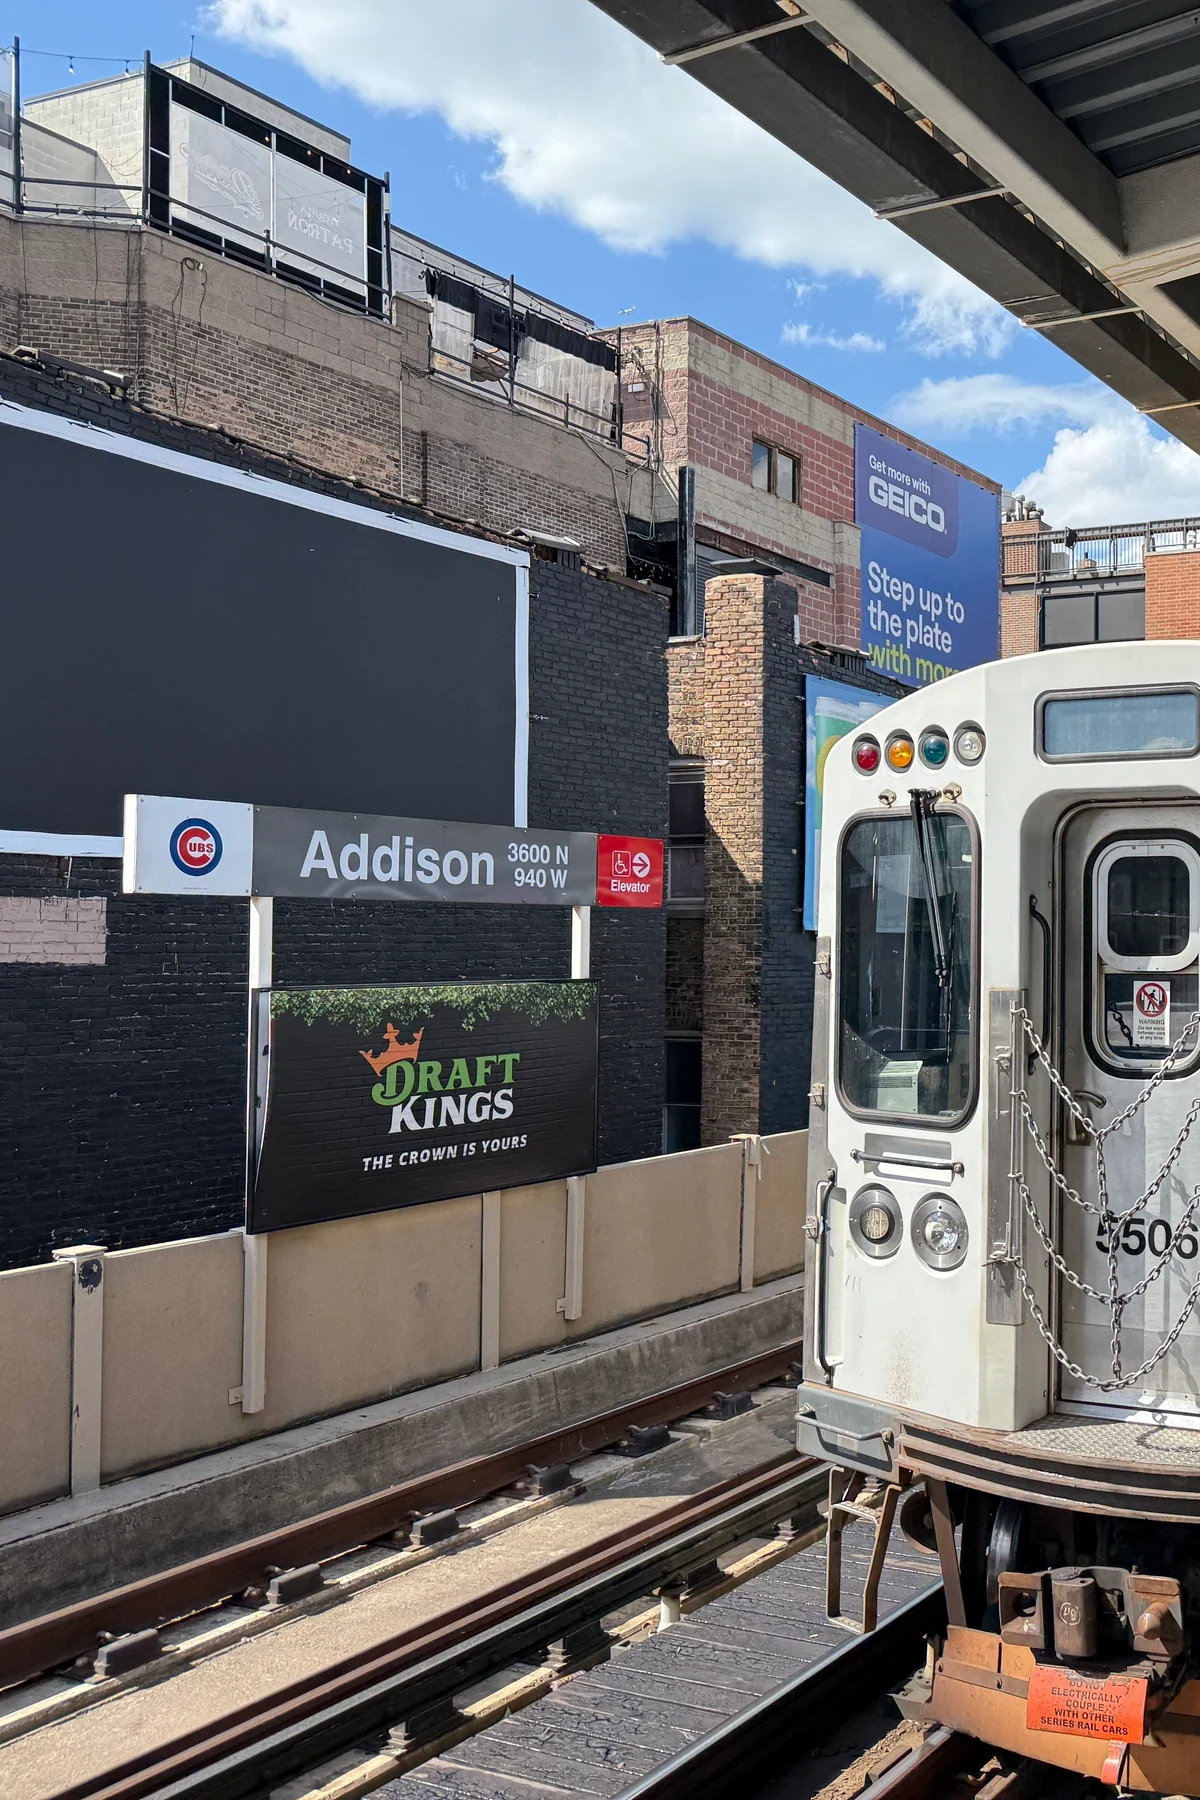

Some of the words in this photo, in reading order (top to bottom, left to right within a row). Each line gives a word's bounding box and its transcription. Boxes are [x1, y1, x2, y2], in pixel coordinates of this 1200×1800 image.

[869, 454, 886, 475] Get
[888, 467, 911, 486] more
[912, 477, 931, 496] with
[869, 475, 945, 533] GEICO
[867, 561, 914, 612] Step
[919, 587, 943, 622] up
[945, 592, 965, 624] to
[867, 599, 902, 637] the
[906, 614, 952, 654] plate
[868, 639, 911, 677] with
[178, 827, 214, 867] CUBS
[299, 829, 495, 886] Addison
[507, 842, 550, 865] 3600
[556, 845, 569, 865] N
[514, 867, 547, 888] 940
[549, 868, 568, 889] W
[610, 879, 651, 893] Elevator
[371, 1053, 521, 1106] DRAFT
[388, 1087, 514, 1134] KINGS
[362, 1154, 394, 1172] THE
[398, 1145, 458, 1166] CROWN
[462, 1142, 476, 1157] IS
[482, 1134, 528, 1153] YOURS
[1095, 1216, 1199, 1259] 5506
[1051, 1686, 1122, 1704] ELECTRICALLY
[1065, 1699, 1105, 1712] COUPLE
[1040, 1716, 1075, 1729] SERIES
[1077, 1721, 1100, 1732] RAIL
[1102, 1724, 1129, 1736] CARS
[1054, 1708, 1079, 1719] WITH
[1081, 1711, 1115, 1724] OTHER
